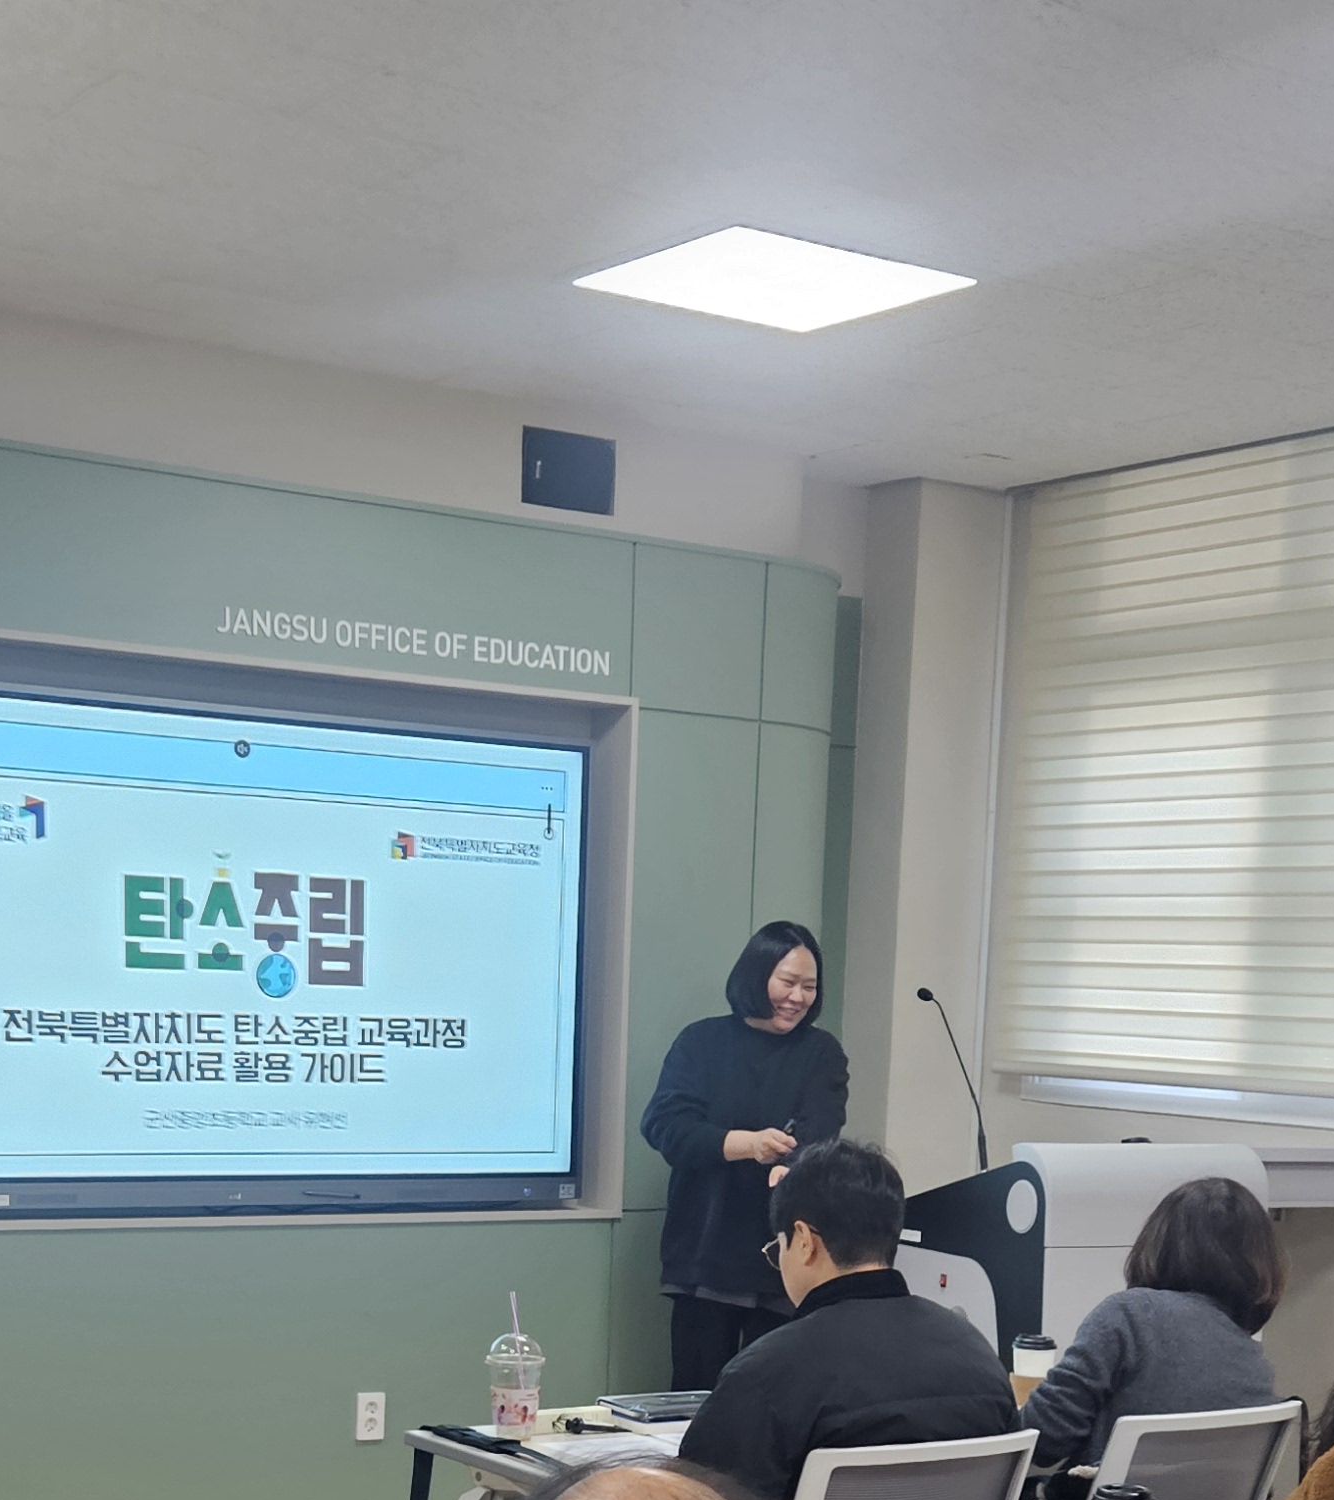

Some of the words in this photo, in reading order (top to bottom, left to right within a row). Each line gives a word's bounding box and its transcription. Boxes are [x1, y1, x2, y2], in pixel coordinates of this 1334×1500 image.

[217, 606, 328, 644] JANGSU
[335, 619, 428, 656] OFFICE
[435, 631, 467, 660] OF
[473, 636, 611, 676] EDUCATION
[420, 836, 540, 858] 전북특별자치도교육청
[124, 868, 365, 998] 탄소중립
[2, 1009, 225, 1045] 전북특별자치도
[233, 1014, 348, 1046] 탄소중립
[358, 1017, 467, 1049] 교육과정
[101, 1050, 225, 1083] 수업자료
[233, 1050, 292, 1083] 활용
[300, 1053, 387, 1084] 가이드
